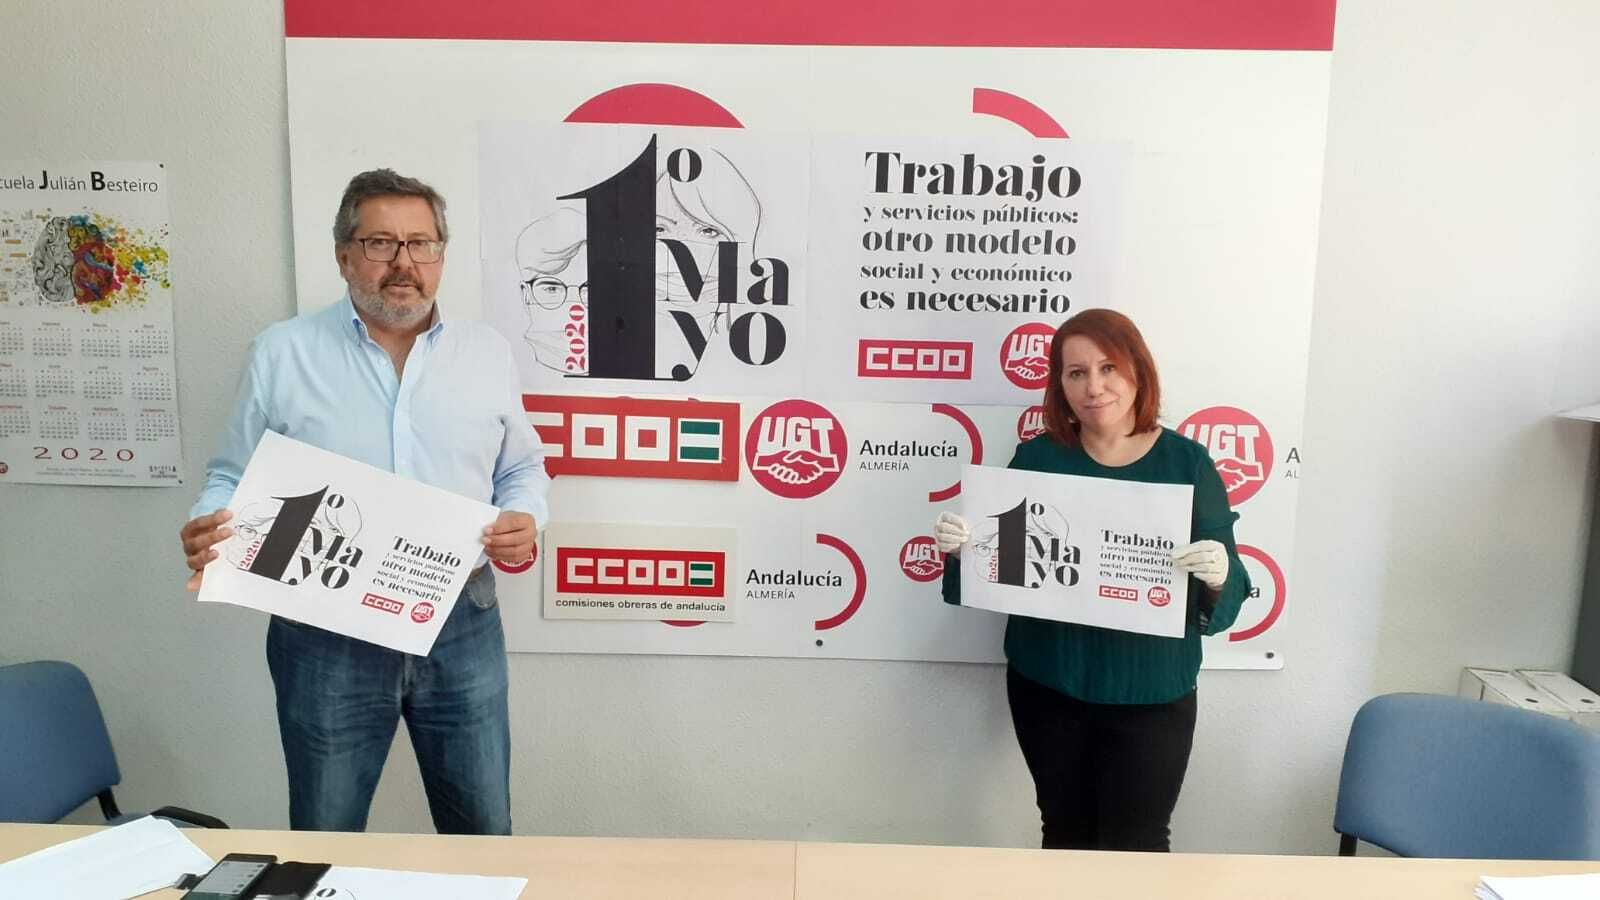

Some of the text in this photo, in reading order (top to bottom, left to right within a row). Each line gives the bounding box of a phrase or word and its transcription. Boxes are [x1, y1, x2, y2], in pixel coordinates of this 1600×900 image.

[39, 169, 86, 190] Julián
[91, 171, 158, 193] Besteiro
[864, 151, 1082, 203] Trabajo
[863, 203, 1078, 225] y servicios públicos:
[862, 227, 1077, 256] otro modelo
[860, 262, 1073, 284] social y económico
[859, 288, 1071, 314] es necesario
[565, 304, 586, 371] 2020
[1008, 333, 1052, 360] UG
[865, 346, 967, 373] CCOO
[757, 416, 834, 457] UGT
[34, 446, 133, 462] 2020
[859, 439, 958, 458] Andalucía
[1100, 529, 1174, 550] Trabajo
[393, 535, 461, 568] Trabajo
[381, 559, 452, 585] otro modelo
[566, 557, 686, 587] CCOO
[746, 568, 843, 587] Andalucía
[1115, 571, 1172, 585] necesario
[387, 581, 442, 602] necesario
[746, 588, 795, 600] ALMERÍA
[1101, 587, 1137, 599] CCOO
[366, 597, 401, 612] CCOO
[555, 598, 615, 609] comisiones
[618, 600, 657, 610] obreras
[660, 601, 673, 610] de
